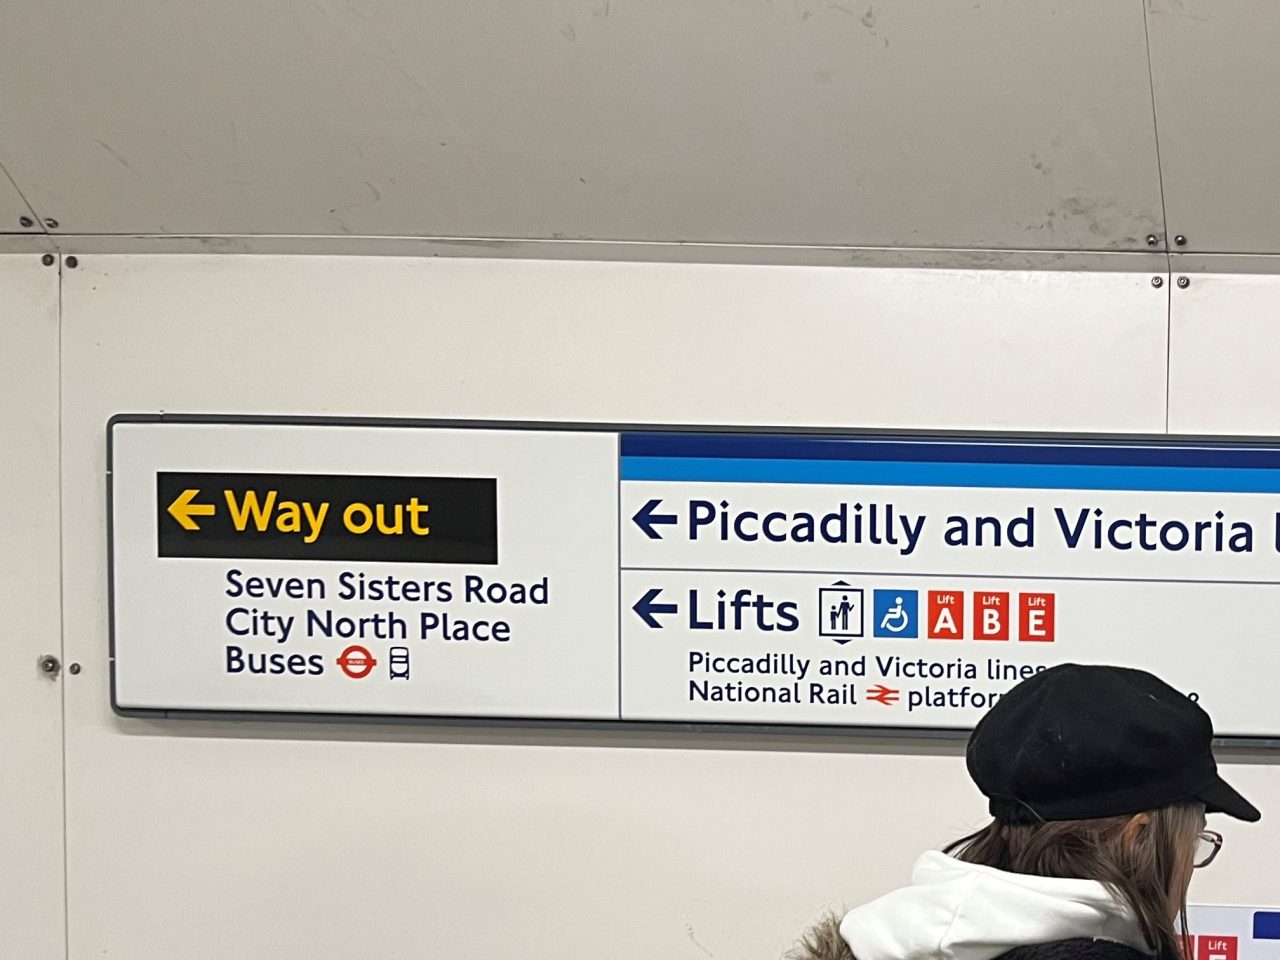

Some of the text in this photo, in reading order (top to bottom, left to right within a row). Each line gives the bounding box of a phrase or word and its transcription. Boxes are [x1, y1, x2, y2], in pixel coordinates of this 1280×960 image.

[223, 489, 430, 544] Way out
[689, 499, 927, 556] Piccadilly
[944, 506, 1035, 548] and
[1053, 507, 1253, 553] Victoria
[225, 569, 548, 605] Seven Sisters Road
[937, 594, 955, 605] Lift
[982, 595, 1001, 606] Lift
[1028, 596, 1046, 607] Lift
[689, 589, 800, 632] Lifts
[933, 607, 958, 634] A
[983, 608, 1001, 635] B
[1028, 609, 1046, 636] E
[225, 607, 511, 644] City North Place
[226, 646, 325, 676] Buses
[689, 651, 809, 680] Piccadilly
[819, 655, 866, 677] and
[875, 655, 977, 680] Victoria
[689, 680, 1004, 712] National Rail platfor
[1208, 940, 1227, 951] Lift
